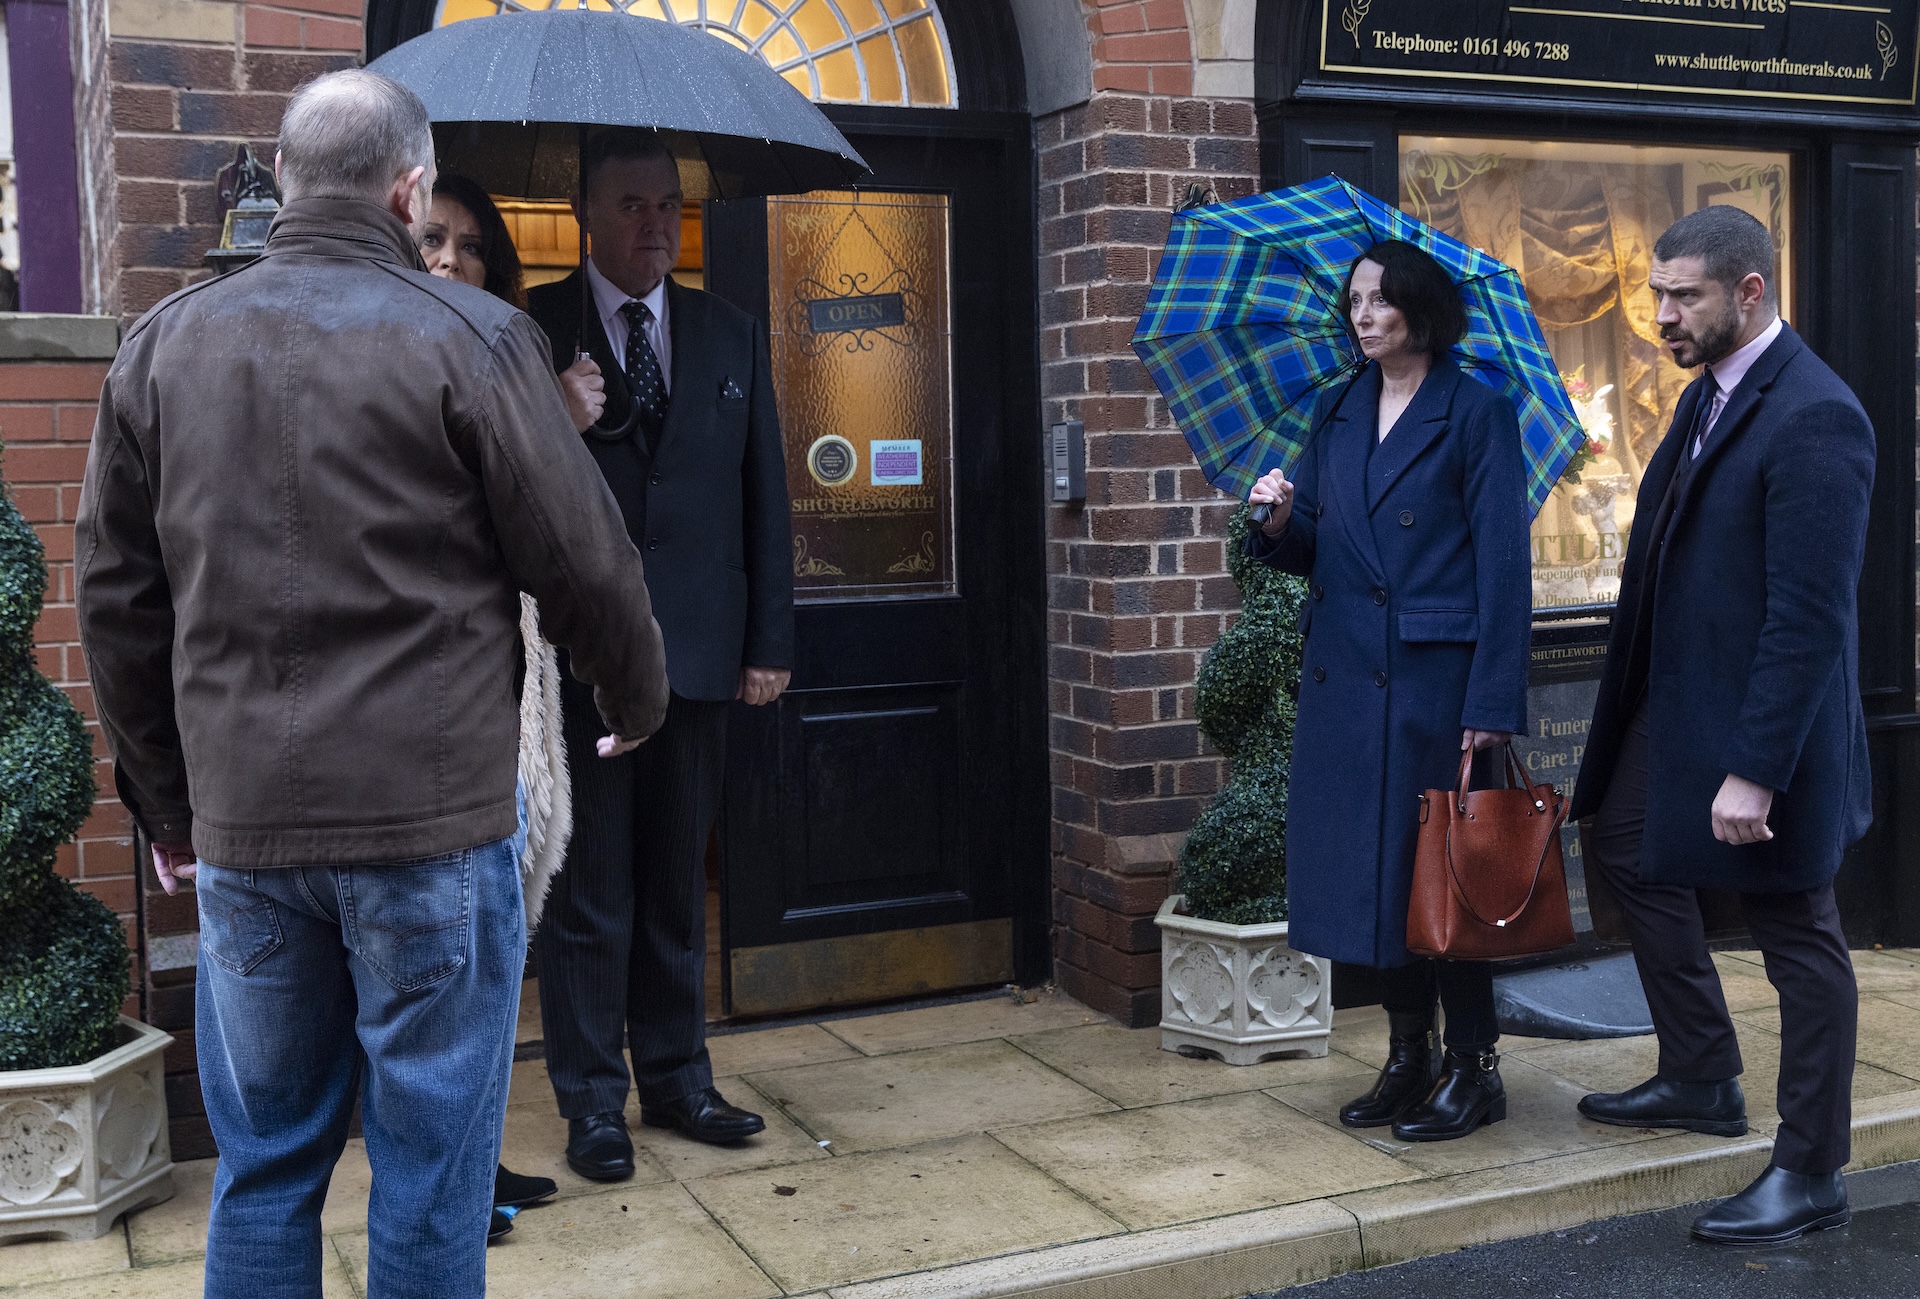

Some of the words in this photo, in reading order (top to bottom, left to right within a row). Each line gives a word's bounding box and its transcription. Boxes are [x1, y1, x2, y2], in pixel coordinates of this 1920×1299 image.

[1372, 30, 1459, 54] Telephone:
[1463, 37, 1499, 56] 0161
[1503, 39, 1530, 59] 496
[1534, 41, 1570, 62] 7288
[1655, 53, 1873, 80] www.shuttleworthfunerals.co.uk
[828, 303, 883, 322] OPEN
[791, 496, 935, 512] SHUTTLEWORTH
[1532, 532, 1630, 563] TTLE
[1533, 566, 1591, 583] dependent
[1594, 564, 1618, 577] Fun
[1531, 645, 1608, 660] SHUTTLEWORTH
[1539, 718, 1592, 738] Funer
[1526, 750, 1568, 771] Care
[1572, 745, 1585, 765] P
